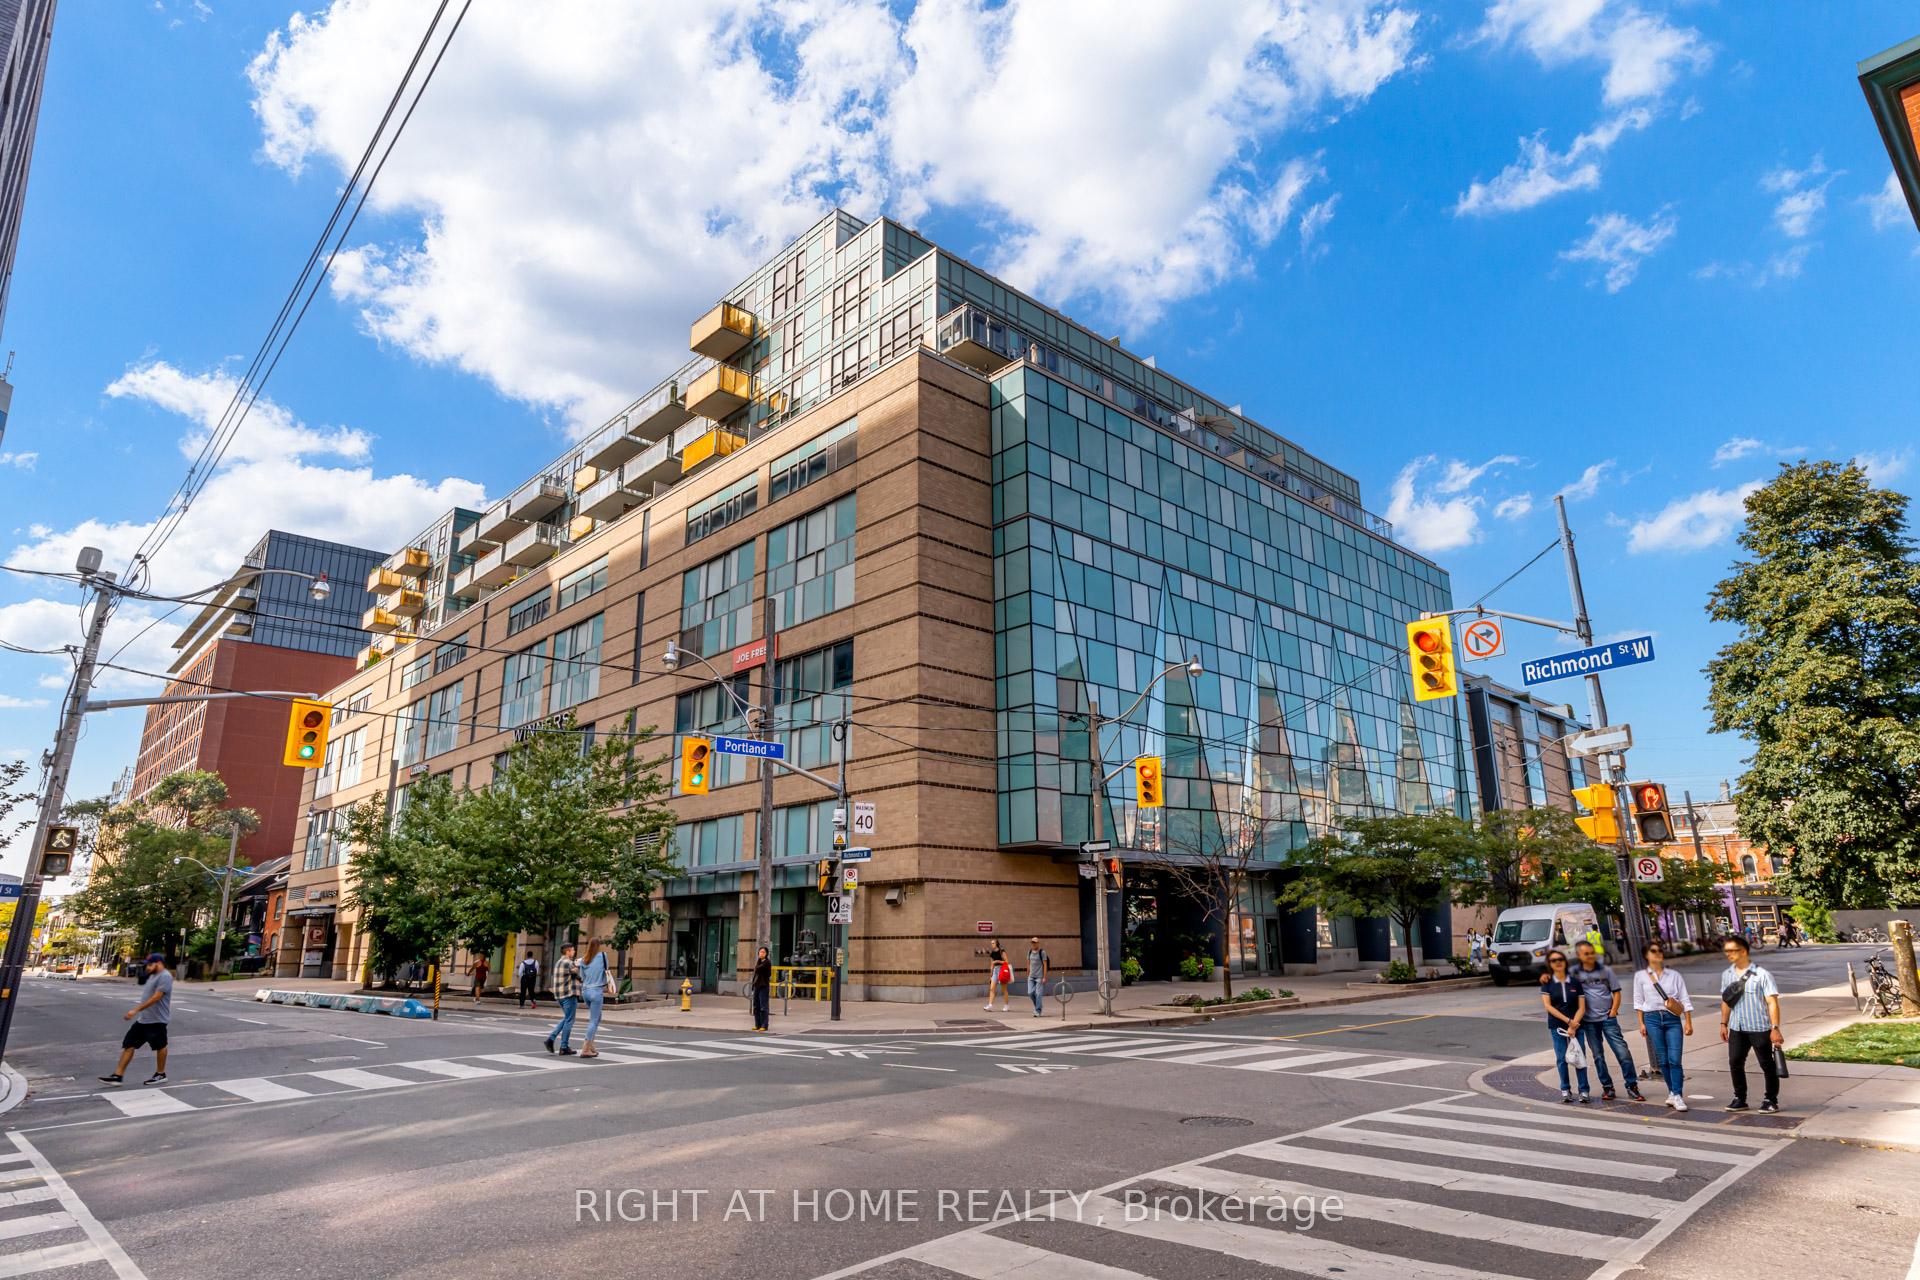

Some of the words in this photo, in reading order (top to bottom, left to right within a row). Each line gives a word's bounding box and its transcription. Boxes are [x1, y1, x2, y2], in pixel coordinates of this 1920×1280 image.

[735, 651, 750, 664] JOE
[751, 644, 767, 658] FRES
[1525, 647, 1613, 681] Richmond
[1618, 644, 1629, 655] St
[1632, 640, 1649, 659] W
[724, 740, 767, 755] Portland
[856, 815, 873, 829] 40
[4, 886, 12, 895] St
